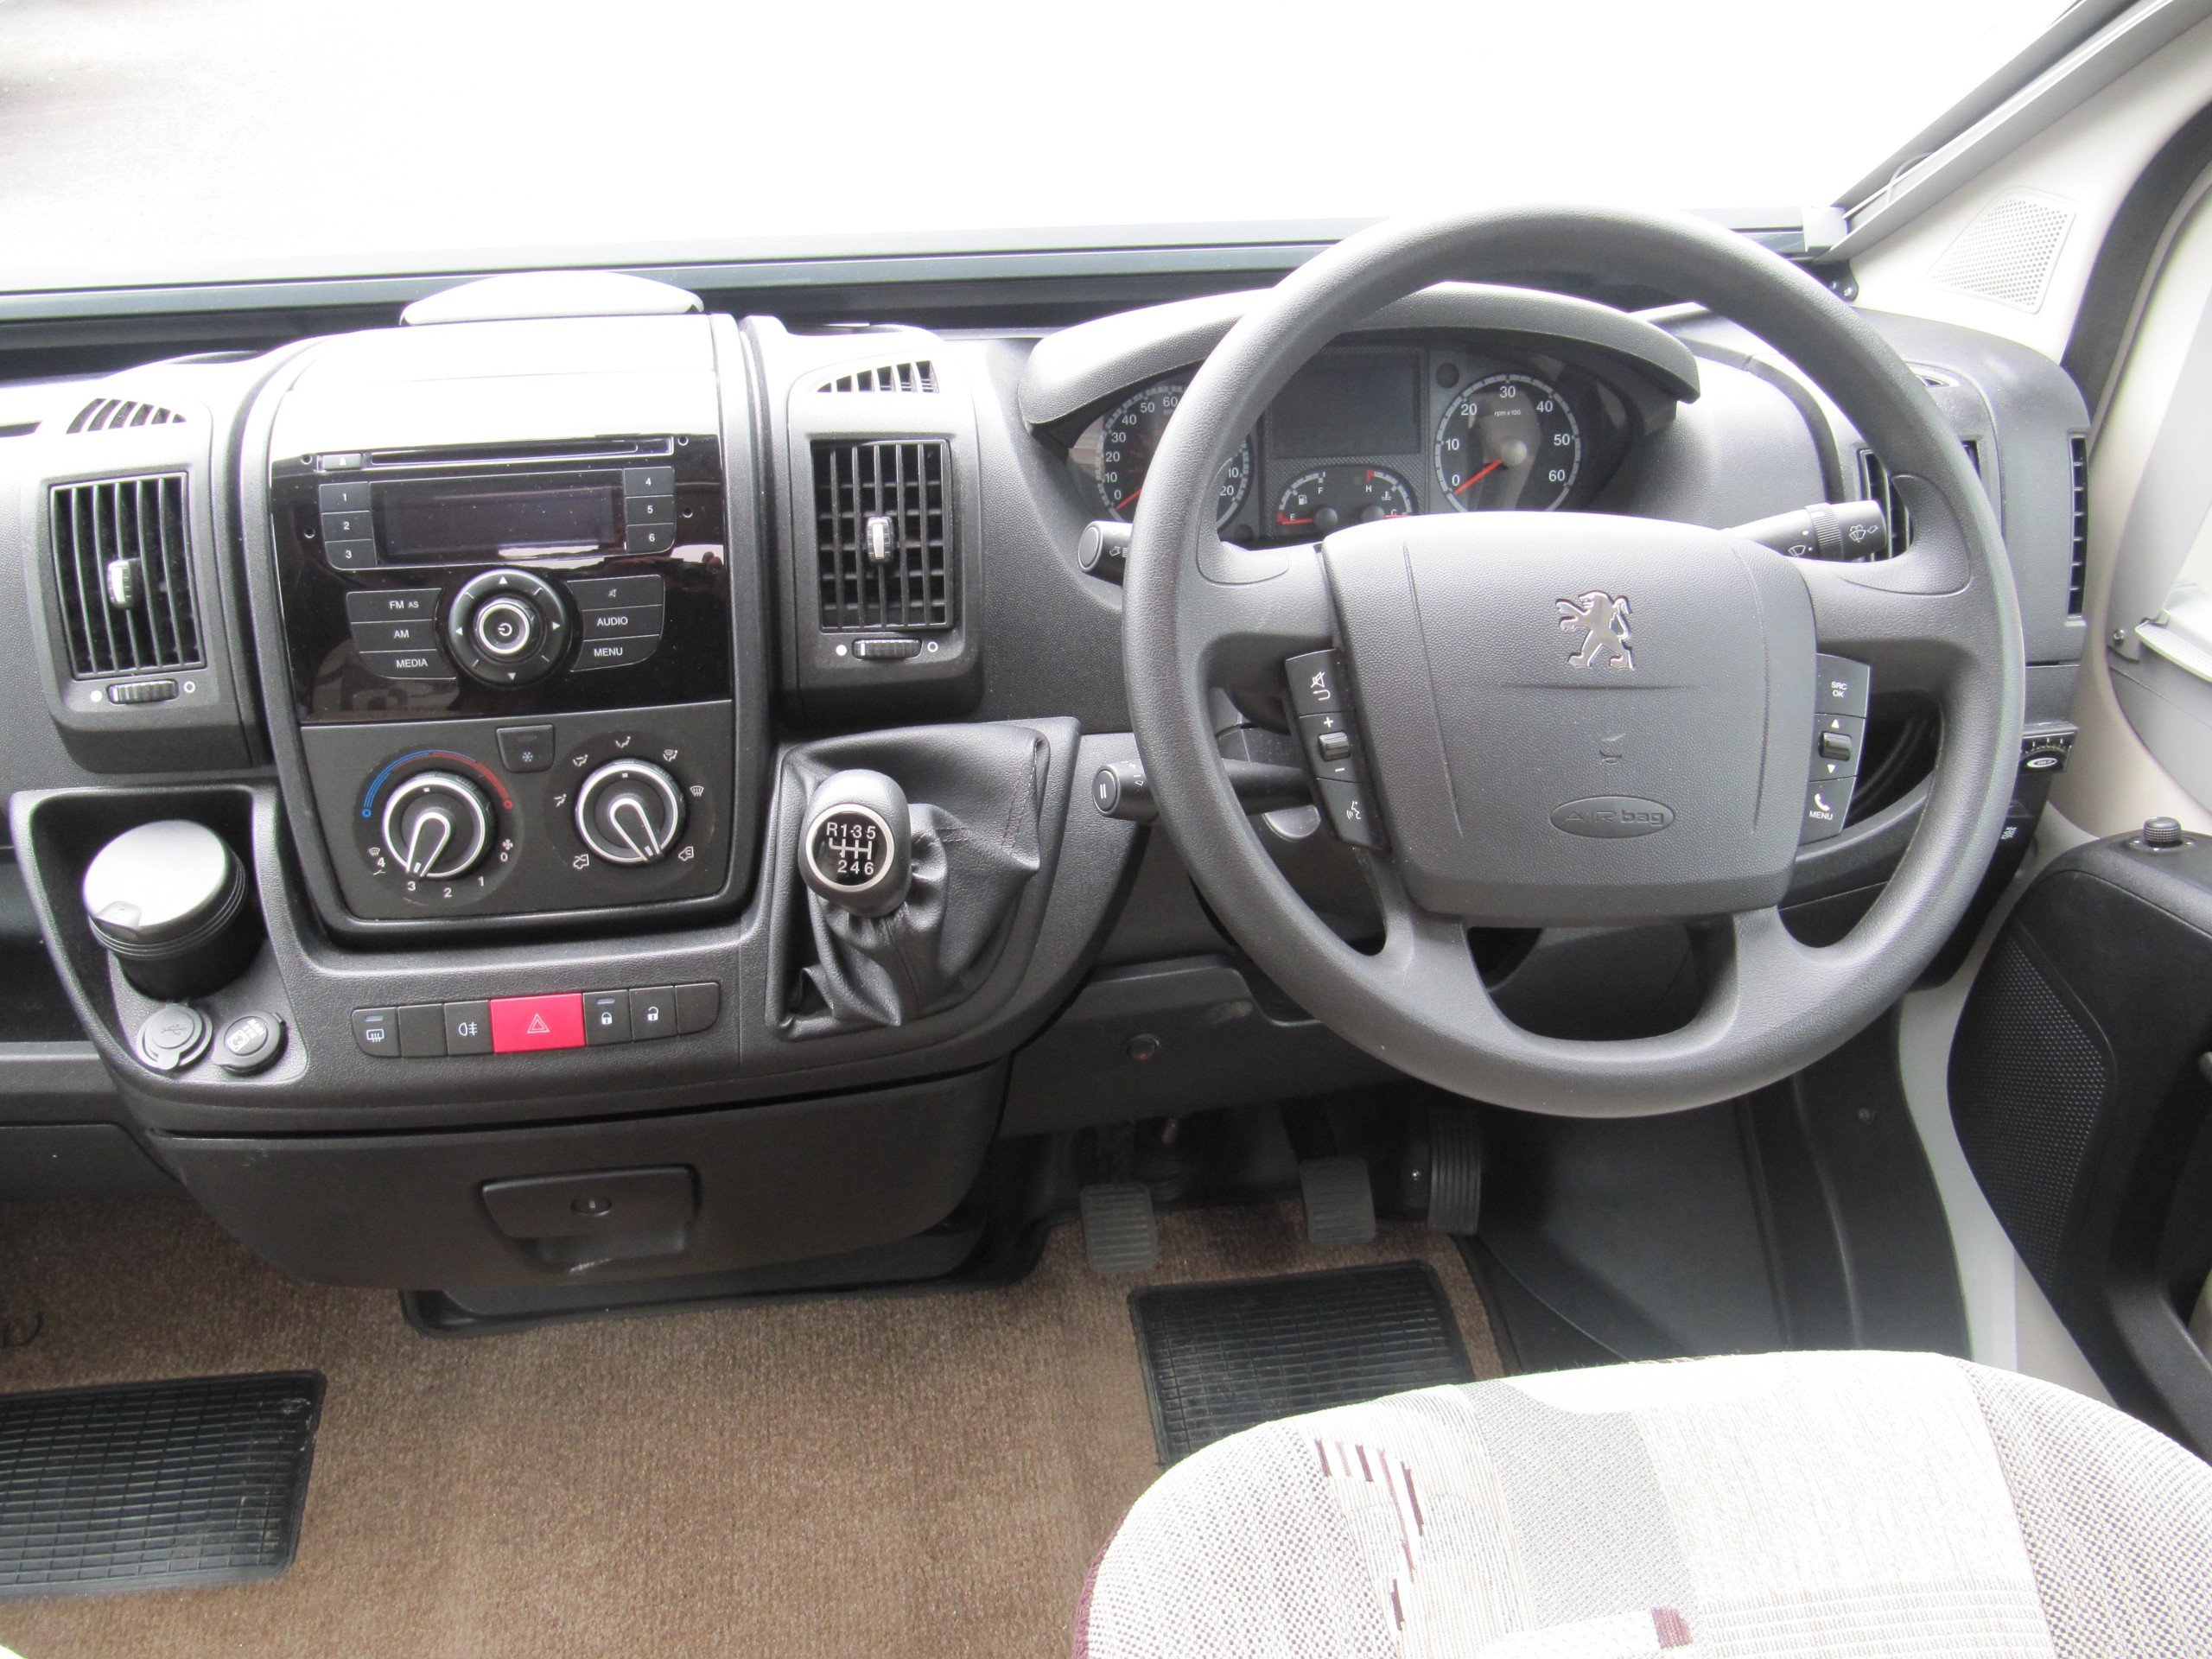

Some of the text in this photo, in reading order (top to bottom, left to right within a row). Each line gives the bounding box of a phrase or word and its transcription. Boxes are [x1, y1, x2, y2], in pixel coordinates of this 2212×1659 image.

[1499, 386, 1516, 398] 30
[1162, 397, 1179, 407] 60
[1536, 400, 1554, 413] 40
[1140, 403, 1155, 412] 50
[1460, 404, 1478, 416] 20
[1122, 415, 1137, 425] 40
[1111, 433, 1127, 442] 30
[1554, 434, 1570, 446] 50
[1446, 438, 1459, 451] 10
[1105, 452, 1121, 462] 20
[1105, 472, 1118, 482] 10
[1452, 474, 1460, 486] 0
[1548, 469, 1566, 482] 60
[645, 477, 653, 487] 4
[342, 493, 348, 503] 1
[1114, 490, 1122, 500] 0
[647, 505, 654, 515] 5
[344, 521, 351, 531] 2
[649, 533, 656, 543] 6
[346, 550, 353, 560] 3
[389, 600, 404, 610] FM
[596, 617, 628, 627] AUDIO
[394, 629, 410, 639] AM
[594, 646, 623, 658] MENU
[396, 658, 428, 669] MEDIA
[1831, 681, 1847, 690] SRC
[1832, 690, 1844, 698] OK
[1808, 810, 1834, 821] MENU
[826, 822, 837, 836] R
[500, 852, 507, 861] 0
[377, 857, 385, 868] 4
[407, 880, 416, 891] 3
[479, 876, 485, 887] 1
[443, 887, 453, 898] 2
